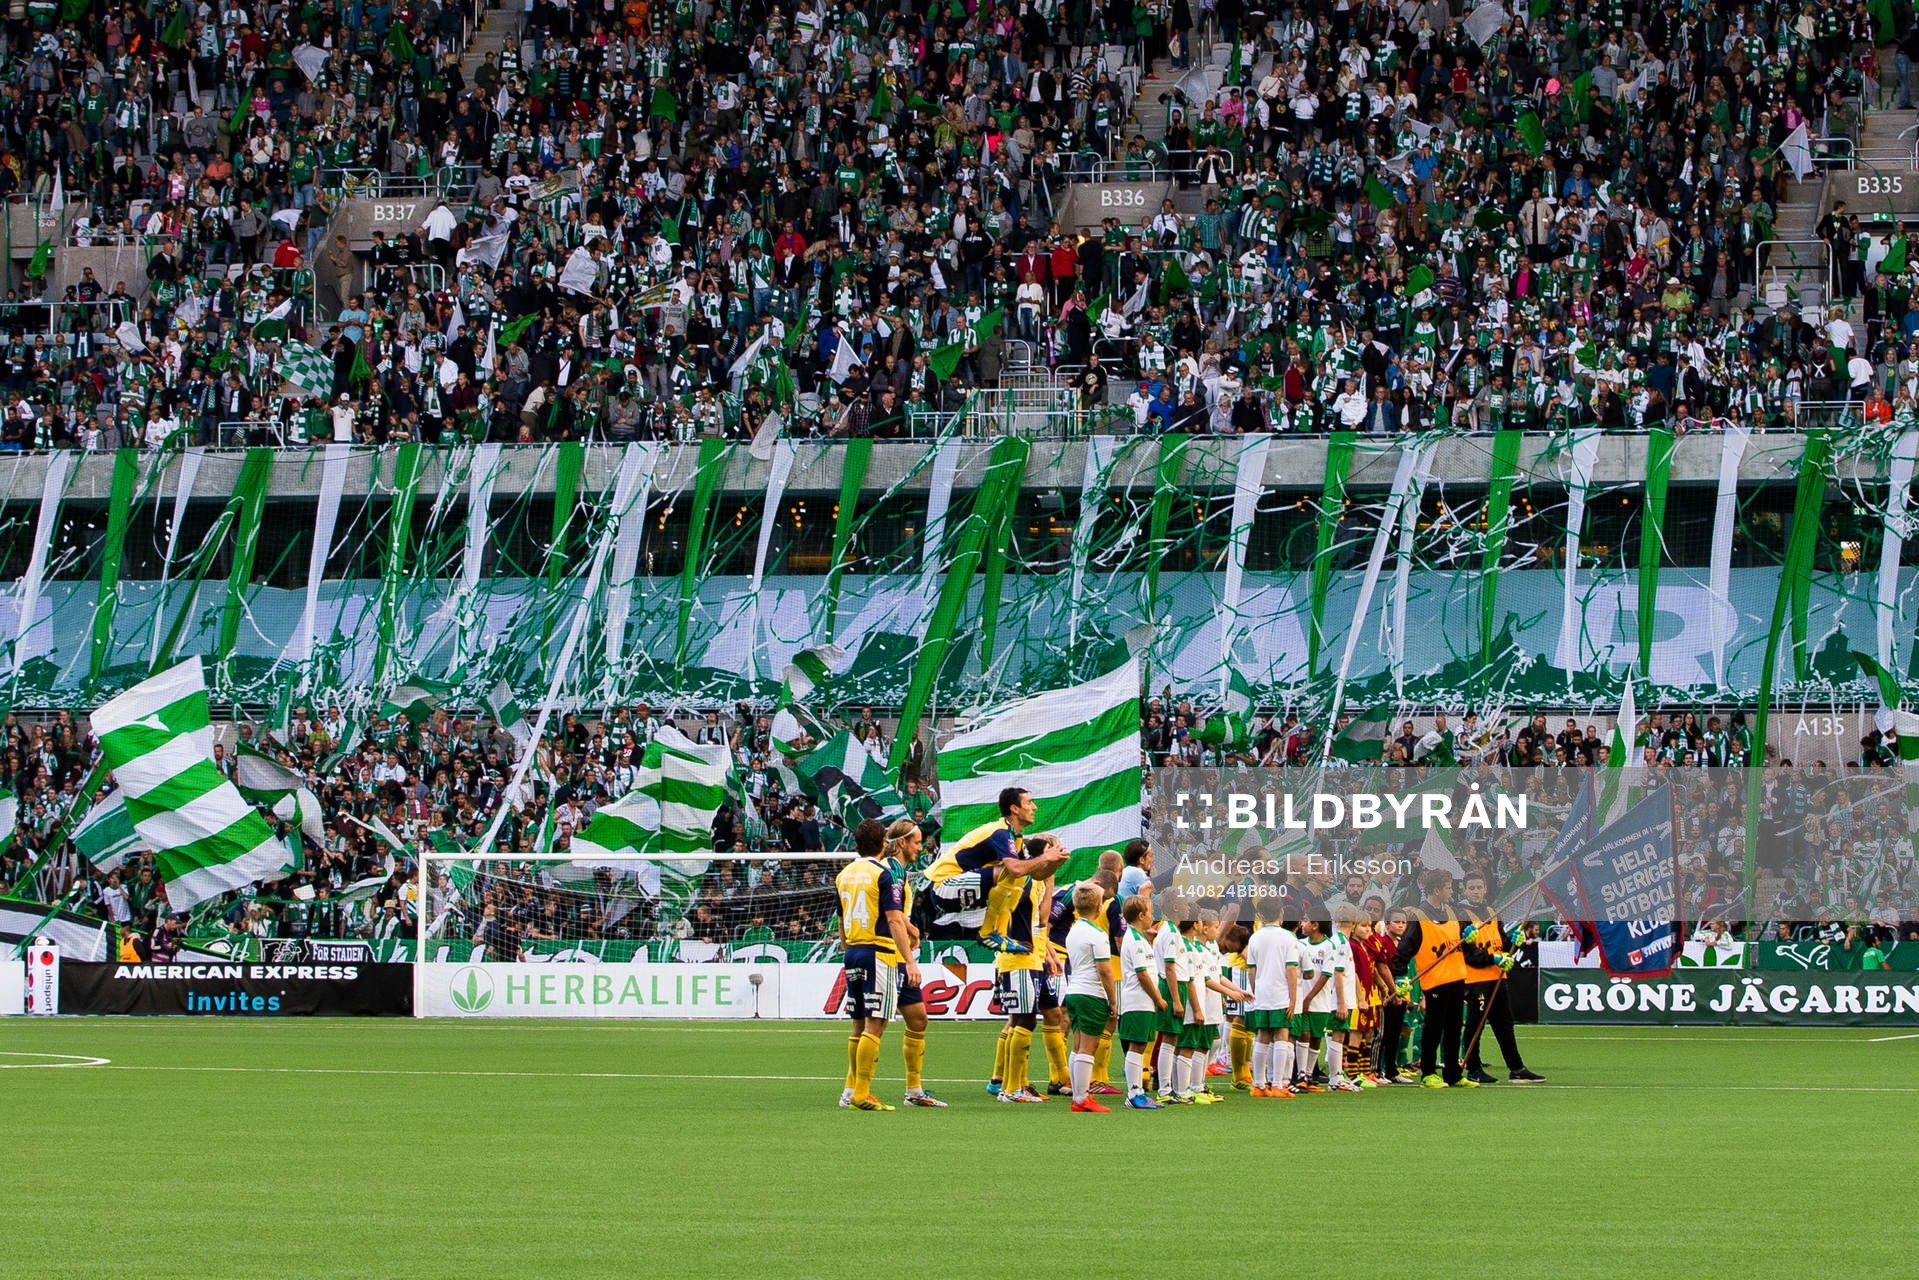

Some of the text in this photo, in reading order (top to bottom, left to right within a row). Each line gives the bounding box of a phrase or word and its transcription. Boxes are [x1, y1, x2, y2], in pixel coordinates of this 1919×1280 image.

[1857, 177, 1903, 194] B335
[1100, 189, 1146, 208] B336
[373, 203, 416, 222] B337
[1794, 718, 1845, 736] A135
[1612, 843, 1657, 875] HELA
[1601, 857, 1674, 902] SVERIGES
[312, 944, 364, 961] FÖR STADEN
[114, 965, 358, 980] AMERICAN EXPRESS
[44, 969, 53, 1012] uhlsport
[507, 975, 732, 1006] HERBALIFE
[1544, 977, 1919, 1013] GRÖNE JÄGAREN
[188, 991, 280, 1011] invites
